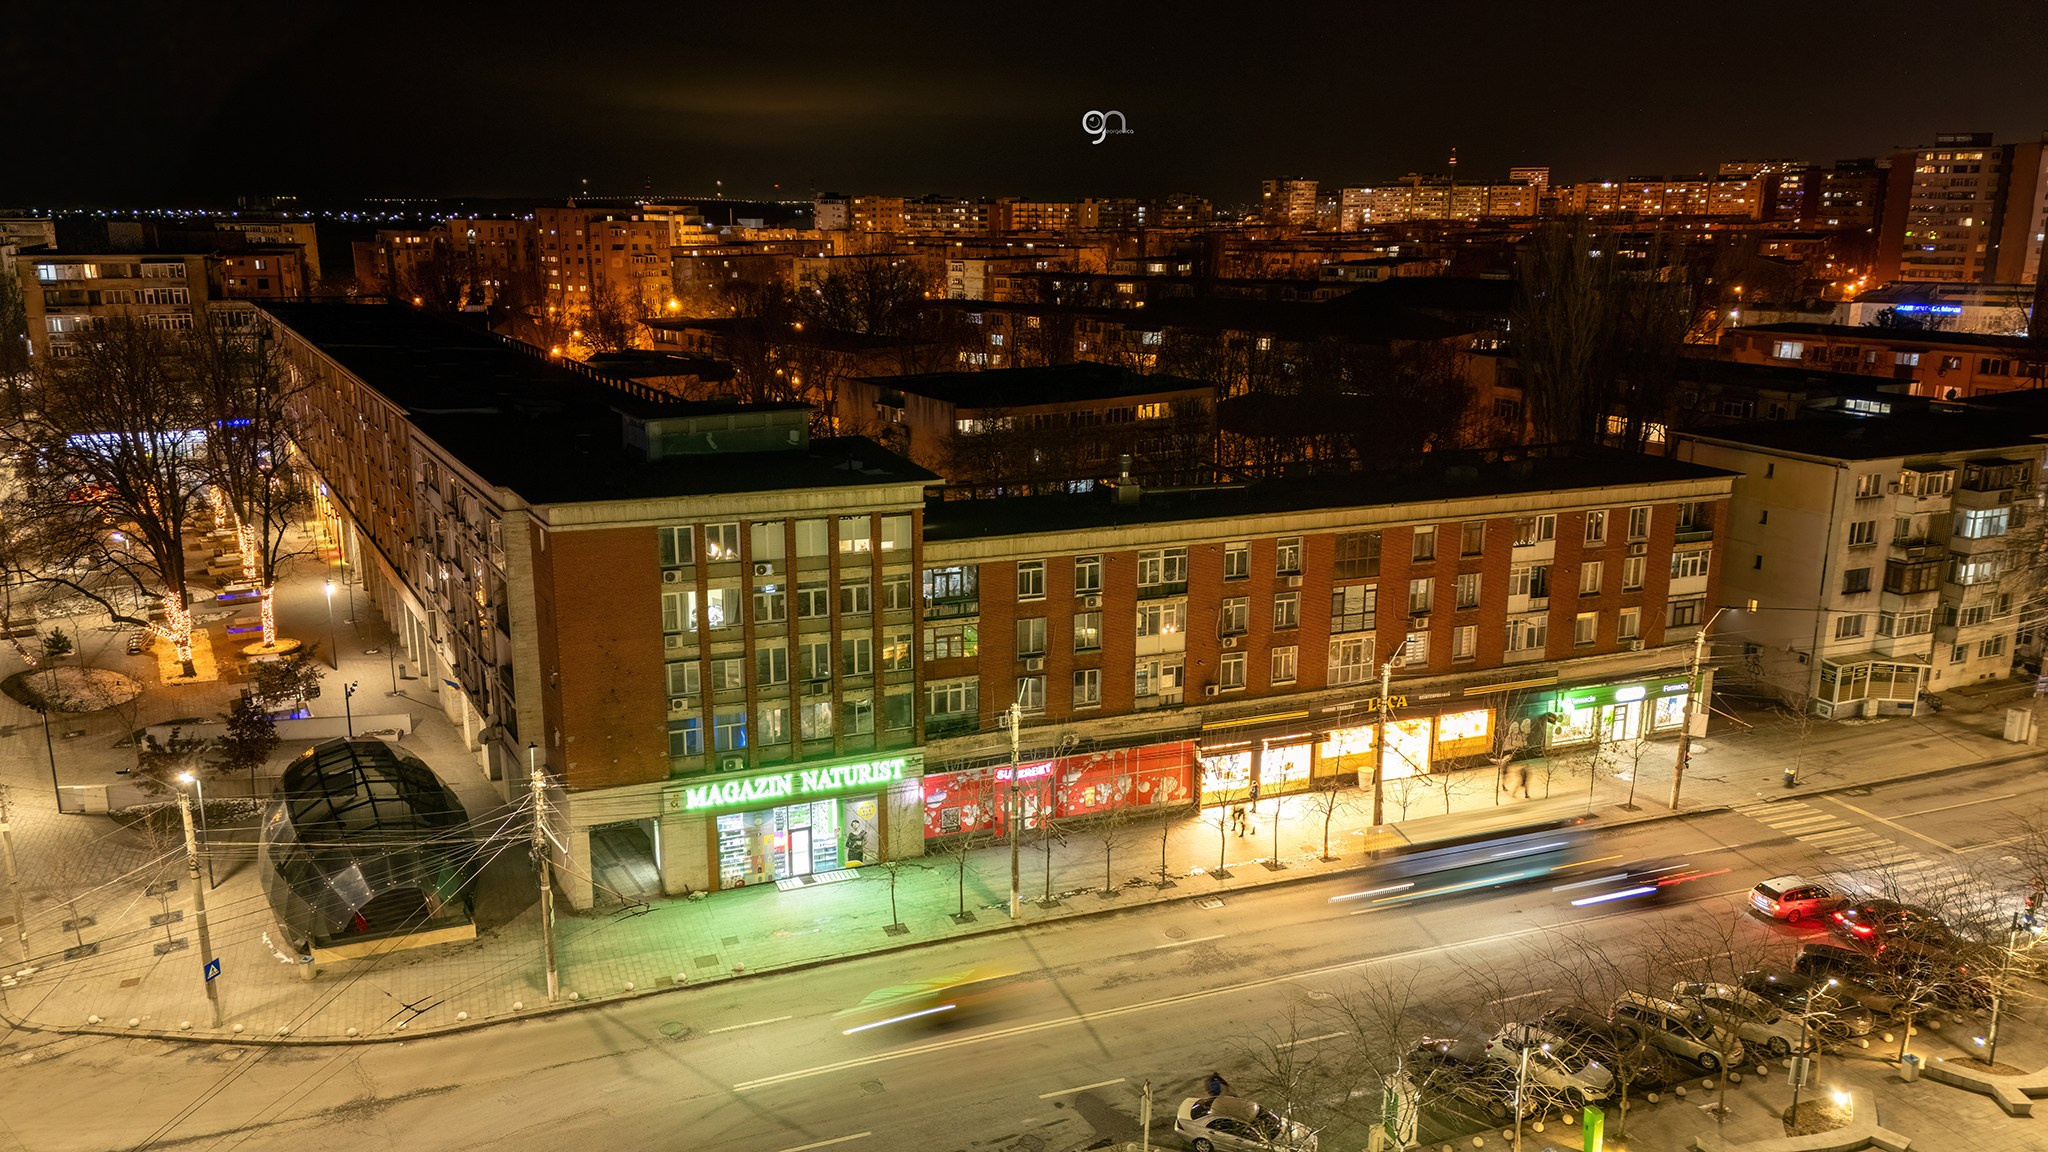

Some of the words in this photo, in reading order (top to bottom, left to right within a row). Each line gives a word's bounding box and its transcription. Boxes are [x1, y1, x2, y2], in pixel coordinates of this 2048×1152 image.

[686, 774, 794, 809] MAGAZIN
[800, 759, 905, 793] NATURIST
[996, 763, 1052, 780] SUERBET
